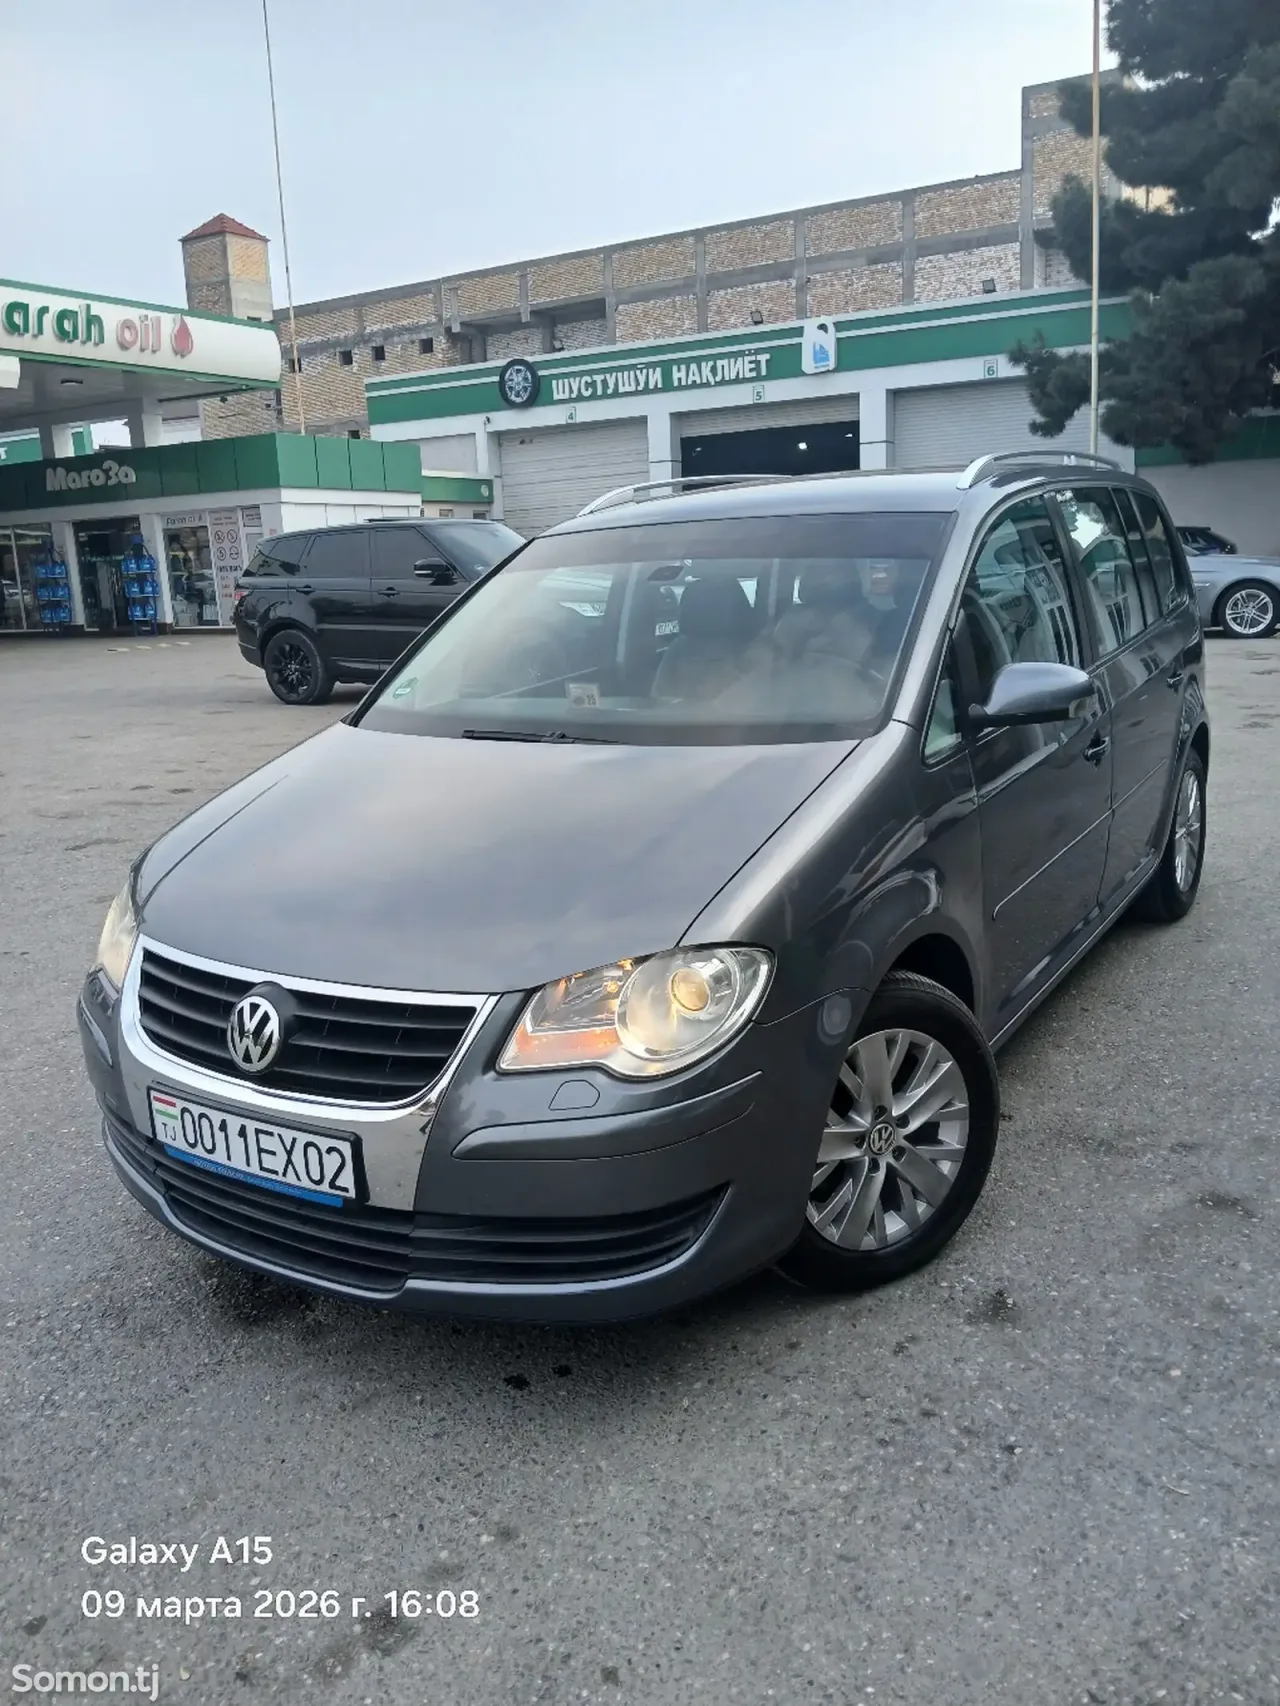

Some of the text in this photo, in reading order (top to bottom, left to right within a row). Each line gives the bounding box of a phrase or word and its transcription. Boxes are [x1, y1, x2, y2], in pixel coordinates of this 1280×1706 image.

[117, 315, 162, 354] oil
[551, 349, 771, 401] ШУСТУШӮИ НАҚЛИЁТ
[987, 365, 996, 377] 6
[755, 390, 763, 401] 5
[161, 1121, 177, 1142] TJ
[180, 1106, 350, 1194] 0011EX02
